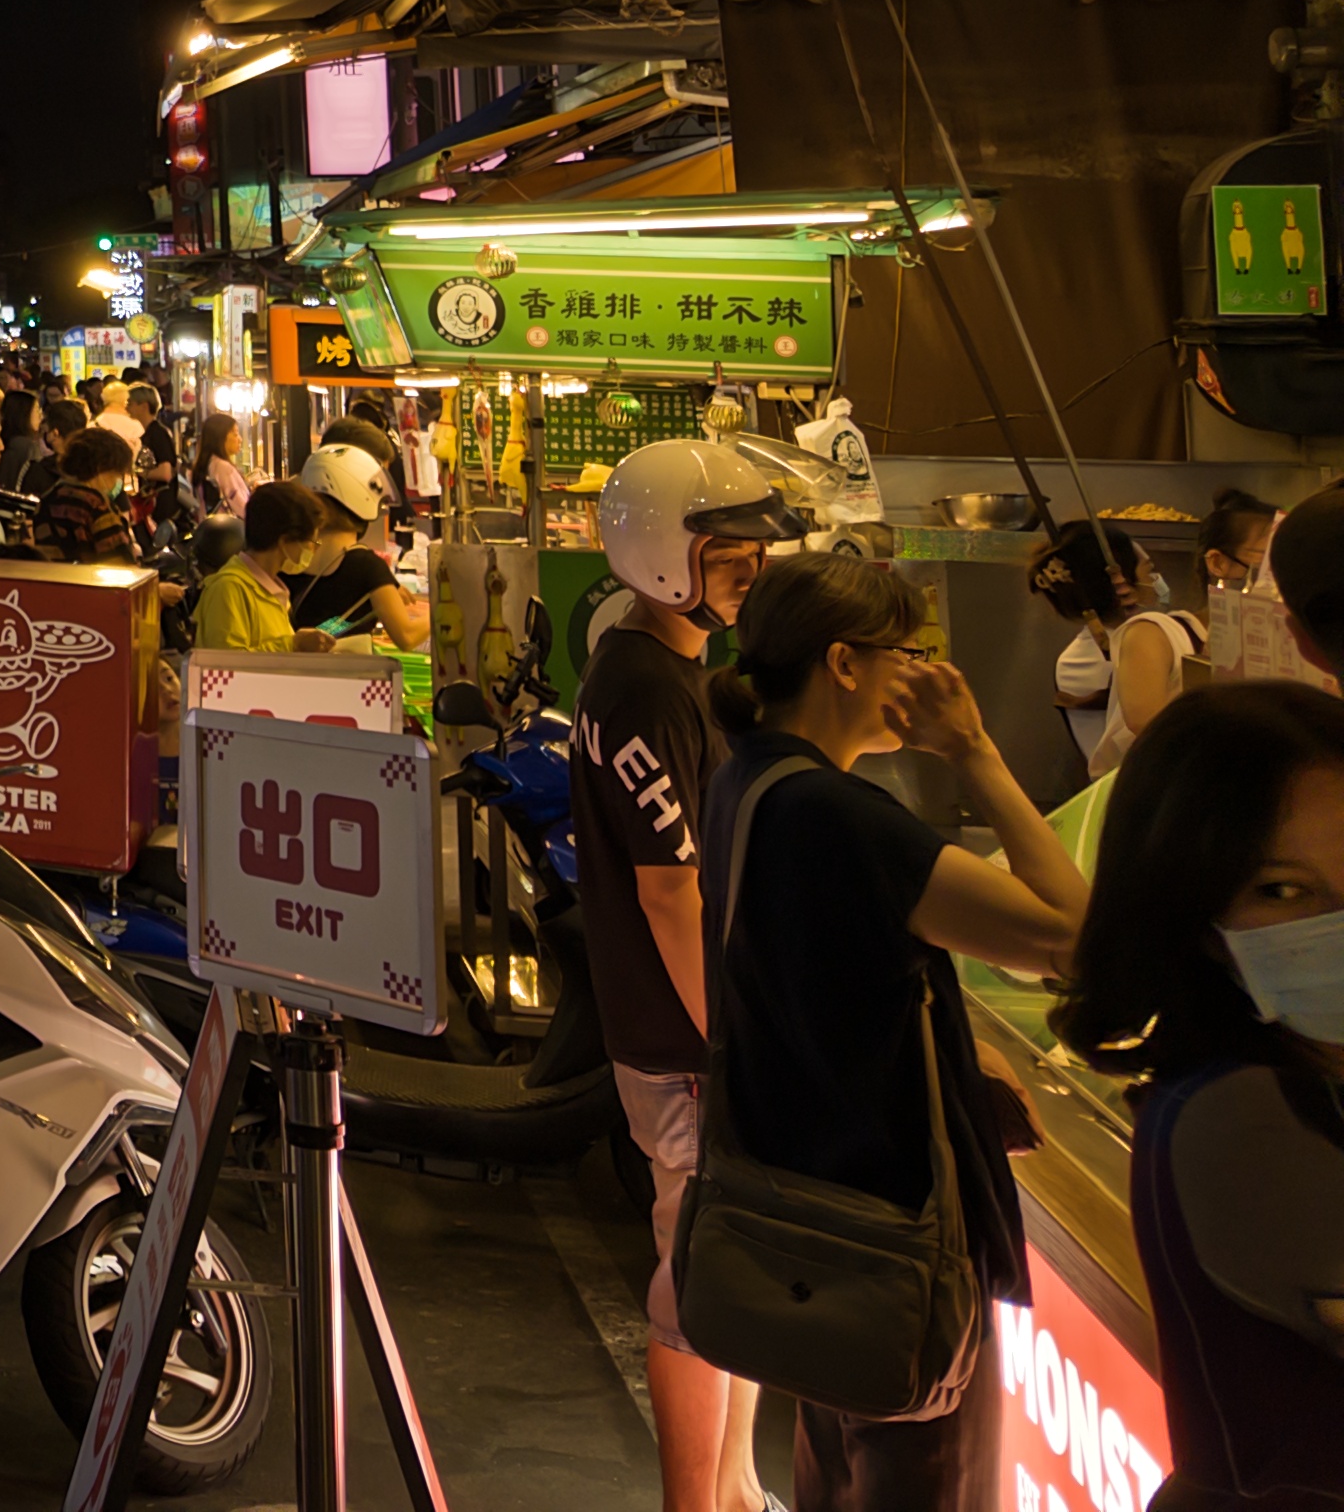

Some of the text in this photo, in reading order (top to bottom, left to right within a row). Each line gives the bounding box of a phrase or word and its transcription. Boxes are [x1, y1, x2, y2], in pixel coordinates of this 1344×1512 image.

[315, 333, 353, 368] 烤
[556, 328, 656, 351] 獨家口味
[666, 332, 769, 355] 特製醬料
[238, 779, 381, 898] 出口
[274, 897, 344, 942] EXIT
